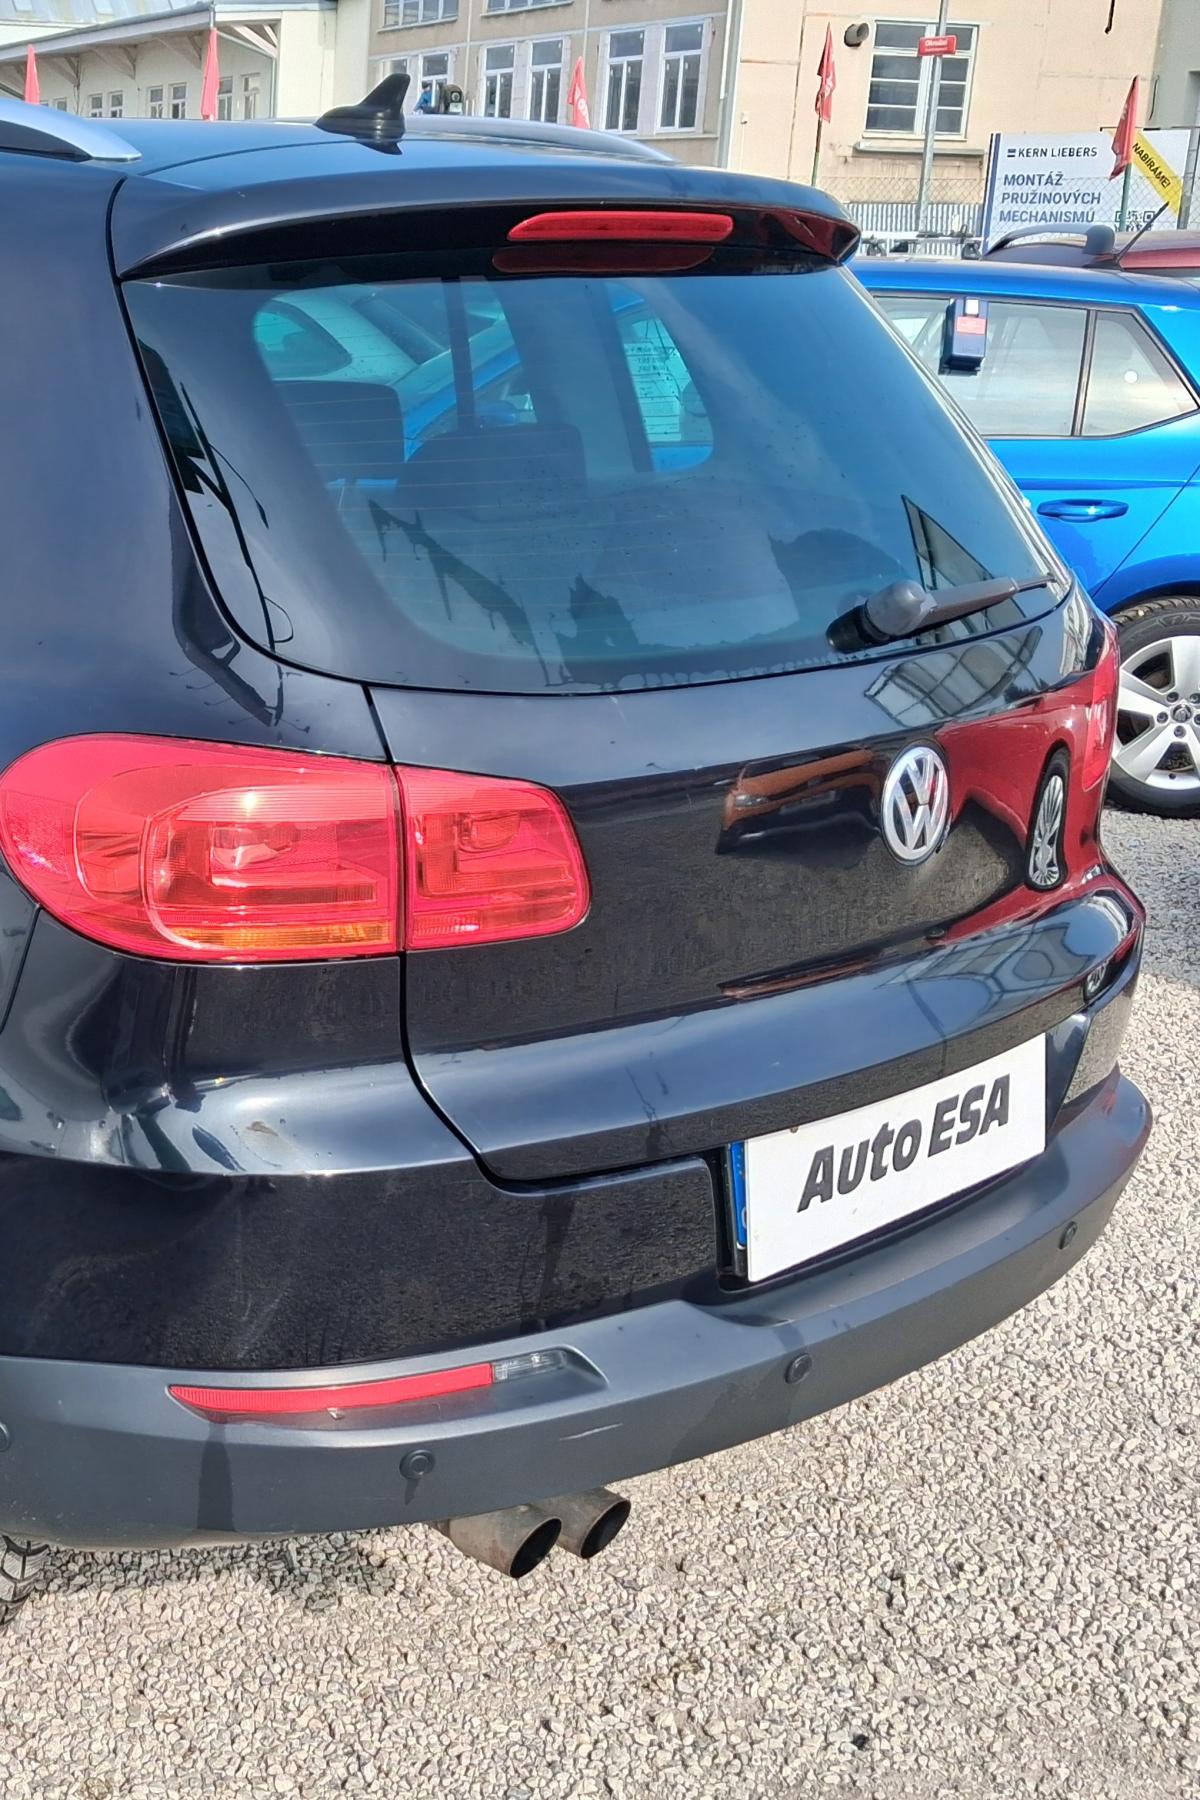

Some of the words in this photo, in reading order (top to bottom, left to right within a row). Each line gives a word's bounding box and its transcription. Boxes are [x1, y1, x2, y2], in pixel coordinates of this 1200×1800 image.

[1018, 147, 1047, 158] KERN
[1051, 147, 1097, 157] LIEBERS
[1132, 143, 1171, 188] NABÍRÁME!
[1003, 171, 1064, 187] MONTÁŽ
[1001, 189, 1100, 205] PRUŽINOVÝCH
[797, 1119, 922, 1213] Auto
[927, 1074, 1010, 1157] ESA
